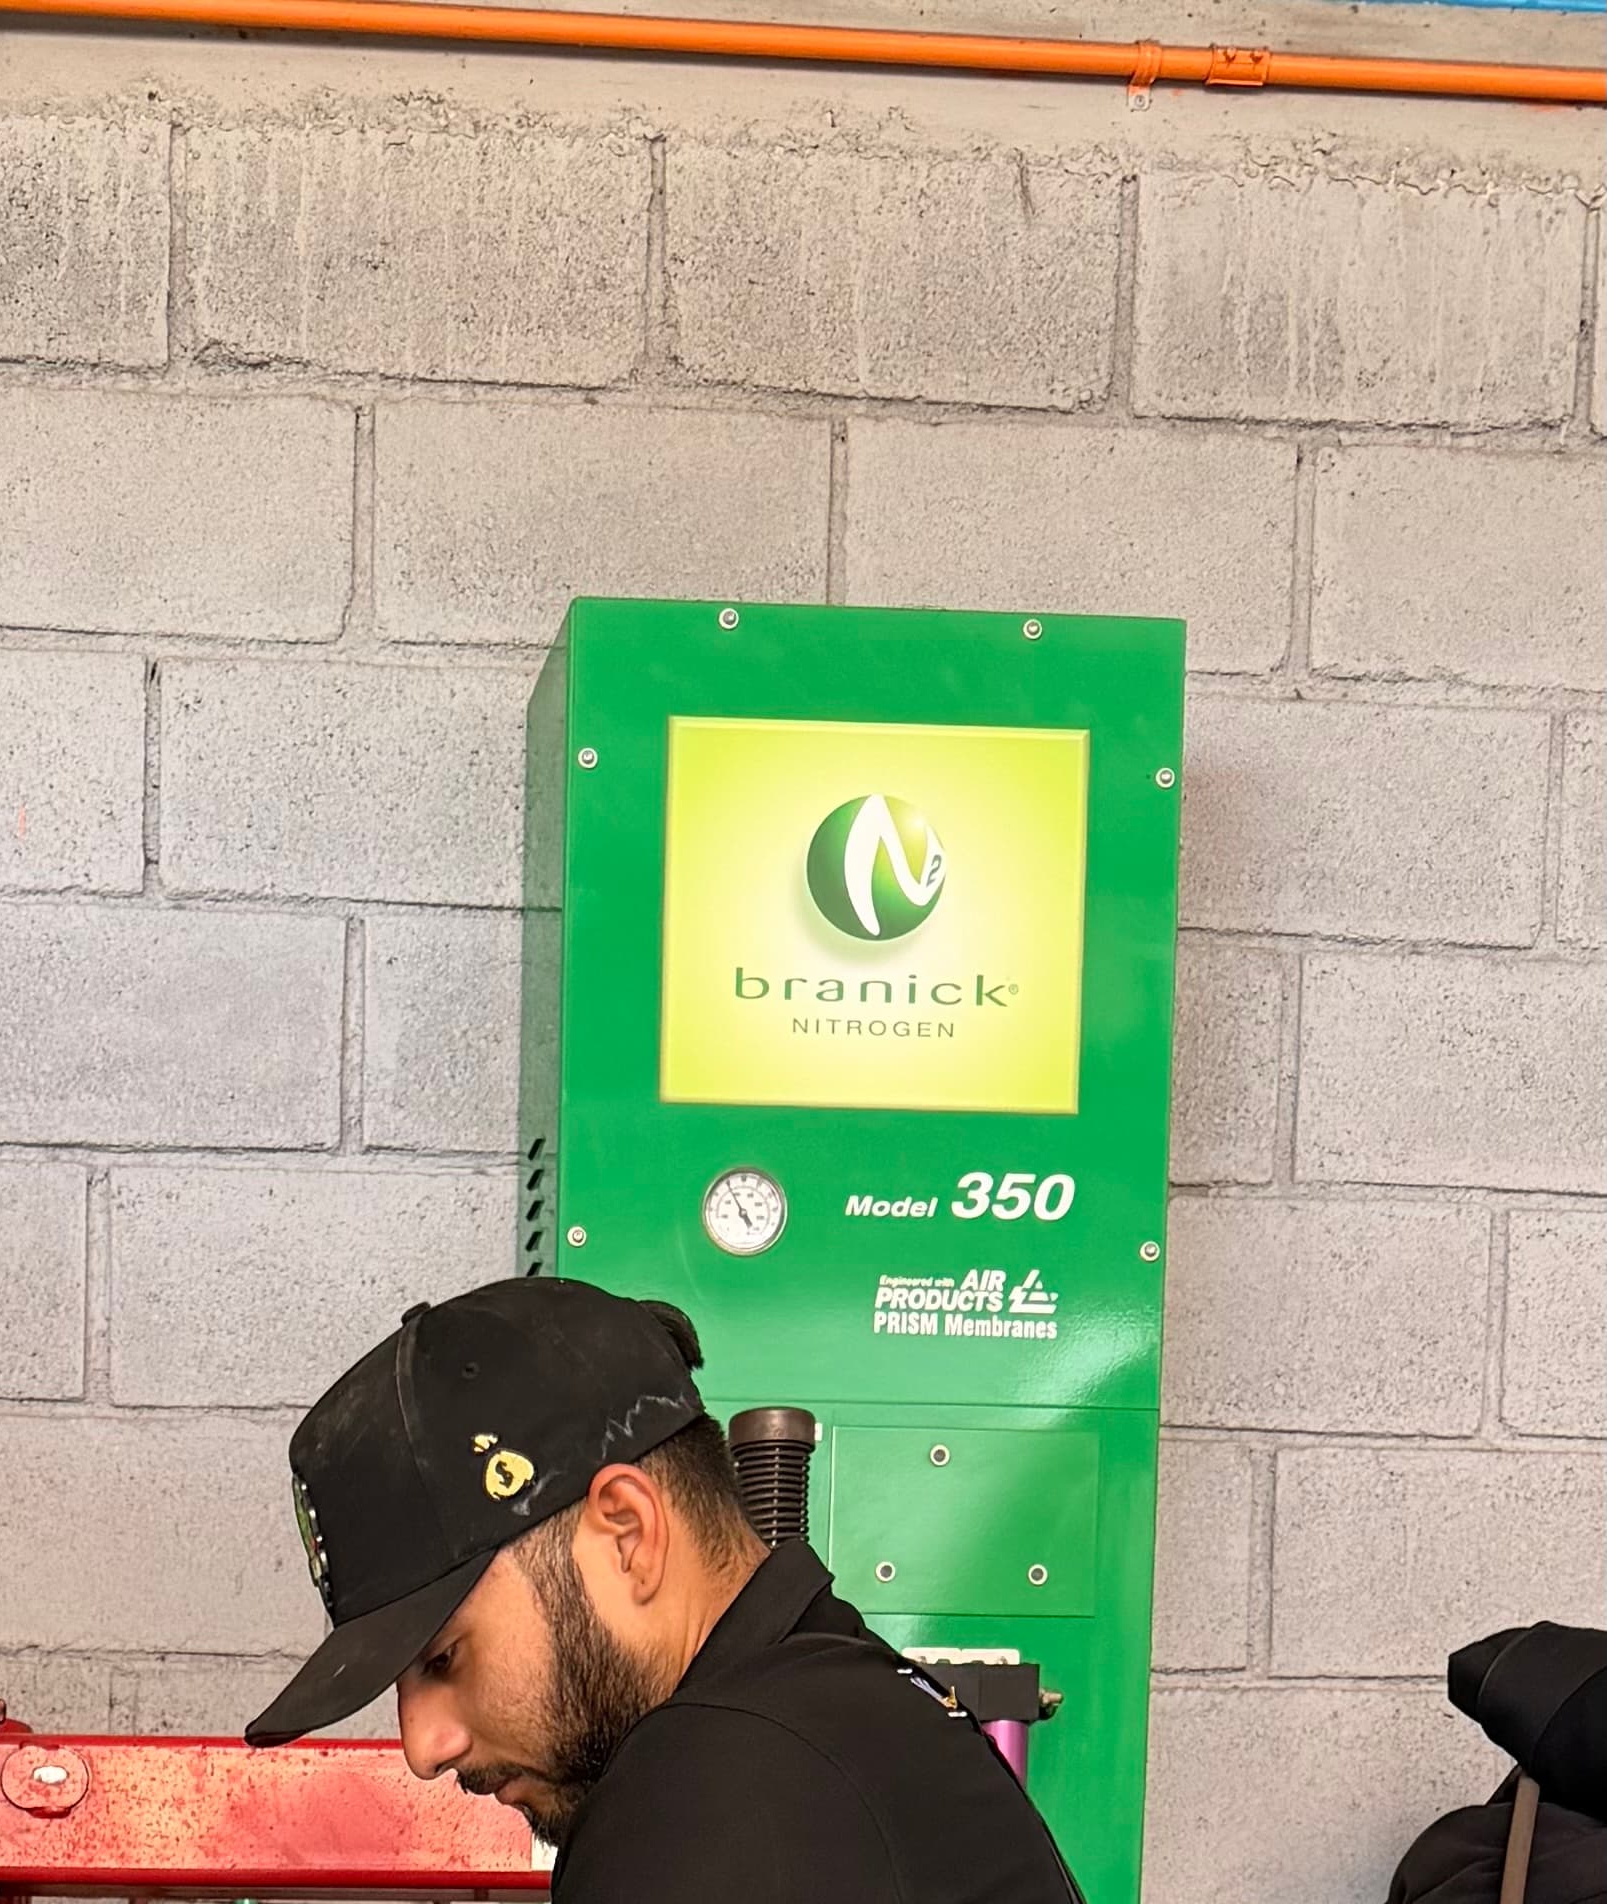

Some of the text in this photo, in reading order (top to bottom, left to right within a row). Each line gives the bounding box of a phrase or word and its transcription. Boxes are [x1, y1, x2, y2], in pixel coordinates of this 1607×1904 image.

[792, 1017, 955, 1038] NITROGEN
[845, 1171, 1075, 1221] Model 350
[879, 1275, 933, 1287] Engineered
[960, 1269, 1006, 1291] AIR
[874, 1287, 1003, 1312] PRODUCTS
[873, 1311, 1058, 1339] PRISM Membranes
